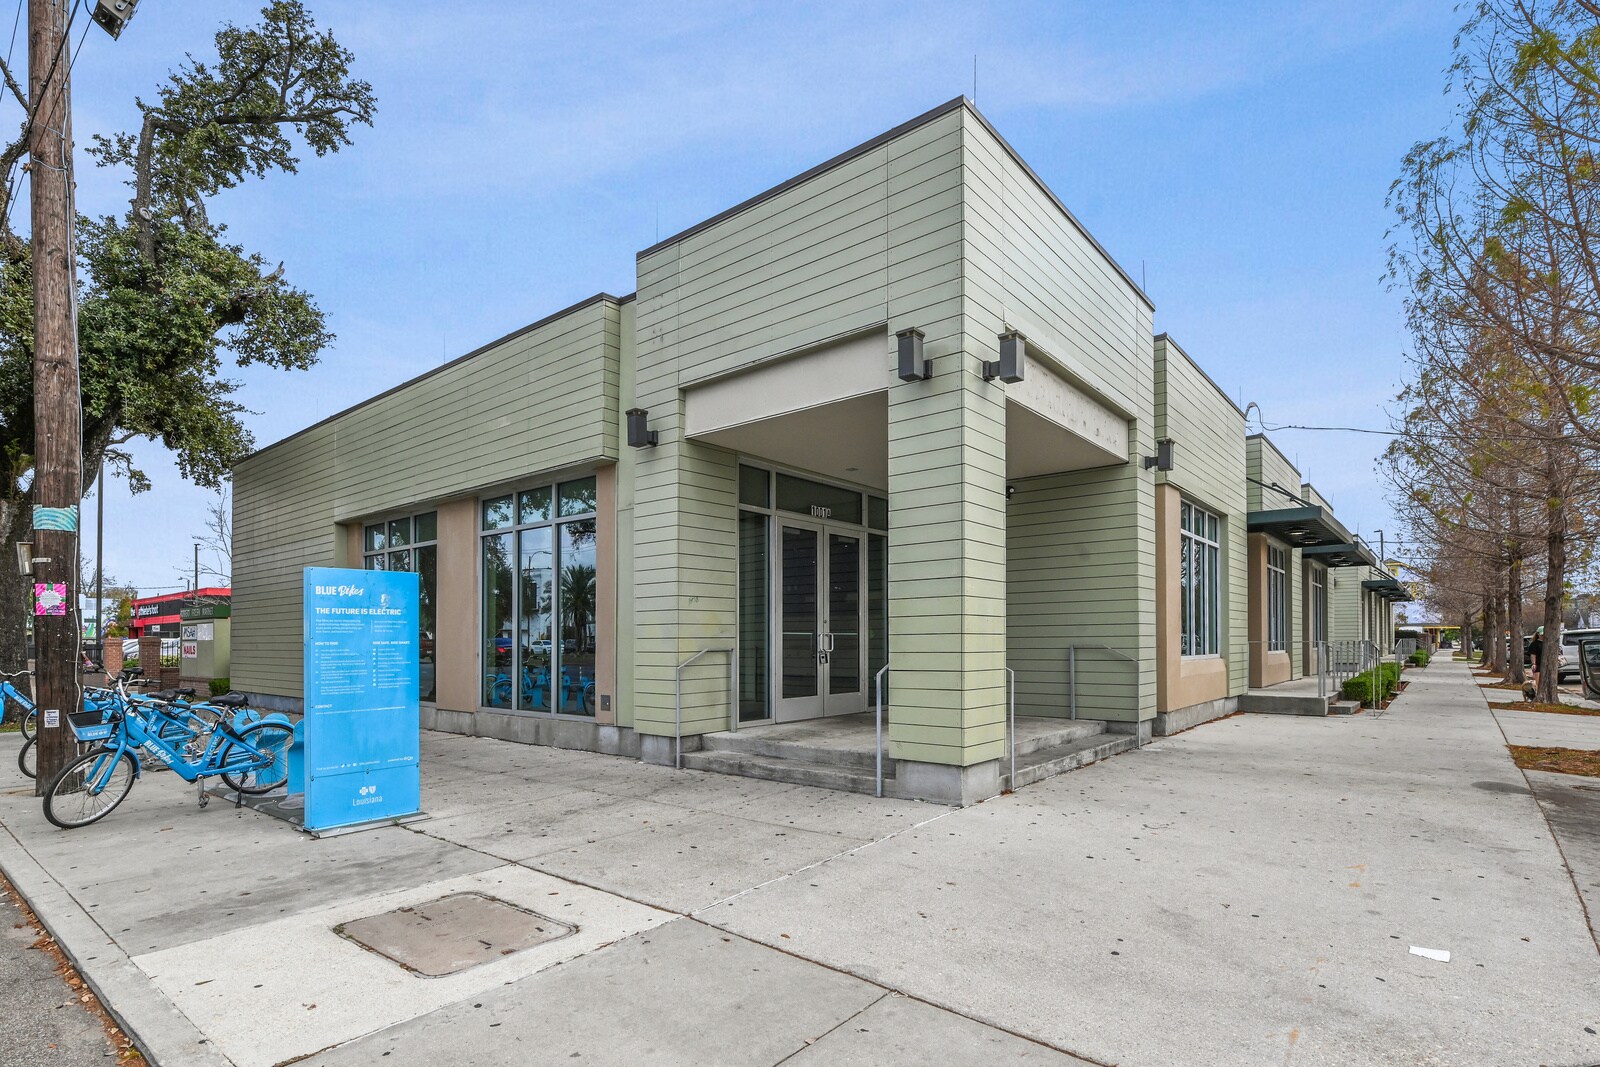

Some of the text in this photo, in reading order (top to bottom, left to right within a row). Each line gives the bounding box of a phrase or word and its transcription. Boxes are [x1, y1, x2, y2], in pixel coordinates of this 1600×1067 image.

[315, 585, 364, 597] BLUE Bikes
[331, 607, 360, 615] FUTURE
[369, 608, 402, 616] ELECTRIC
[183, 645, 196, 655] NAILS
[143, 740, 160, 754] BLUE
[352, 796, 383, 806] Louisiana
